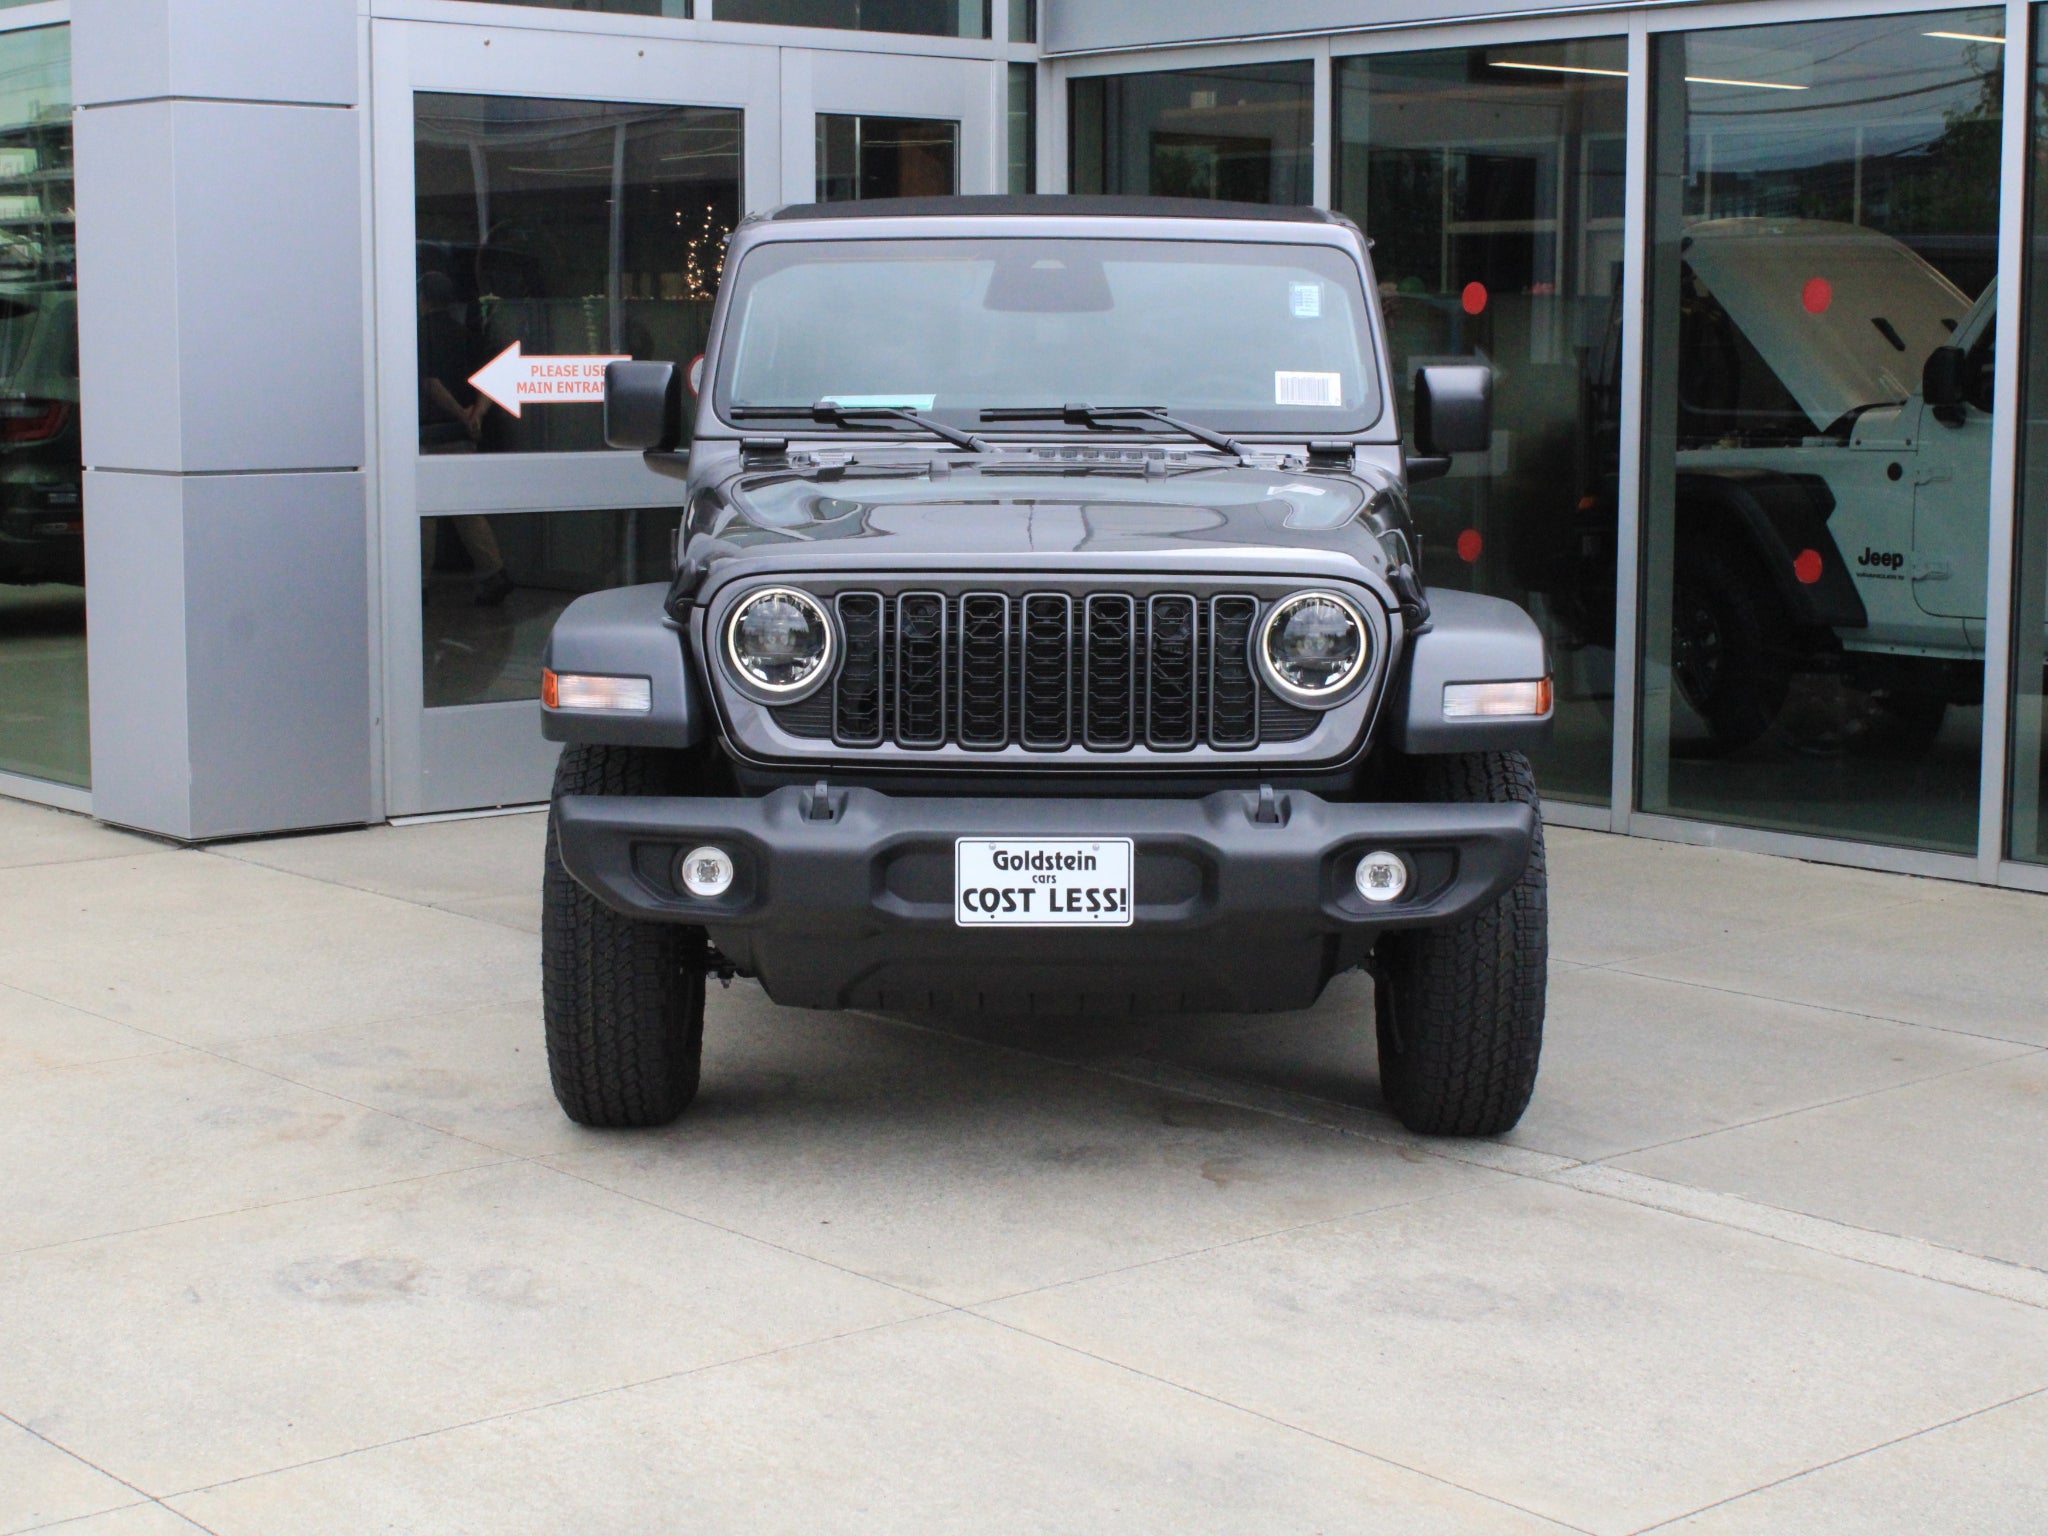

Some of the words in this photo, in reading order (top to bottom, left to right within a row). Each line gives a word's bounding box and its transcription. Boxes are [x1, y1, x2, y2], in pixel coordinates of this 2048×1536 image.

[531, 364, 578, 377] PLEASE
[583, 364, 606, 377] USE
[516, 381, 553, 394] MAIN
[1858, 547, 1904, 571] Jeep
[992, 850, 1097, 871] Goldstein
[1032, 874, 1057, 884] cars
[962, 887, 1036, 913] COST
[1050, 888, 1127, 913] LESS!
